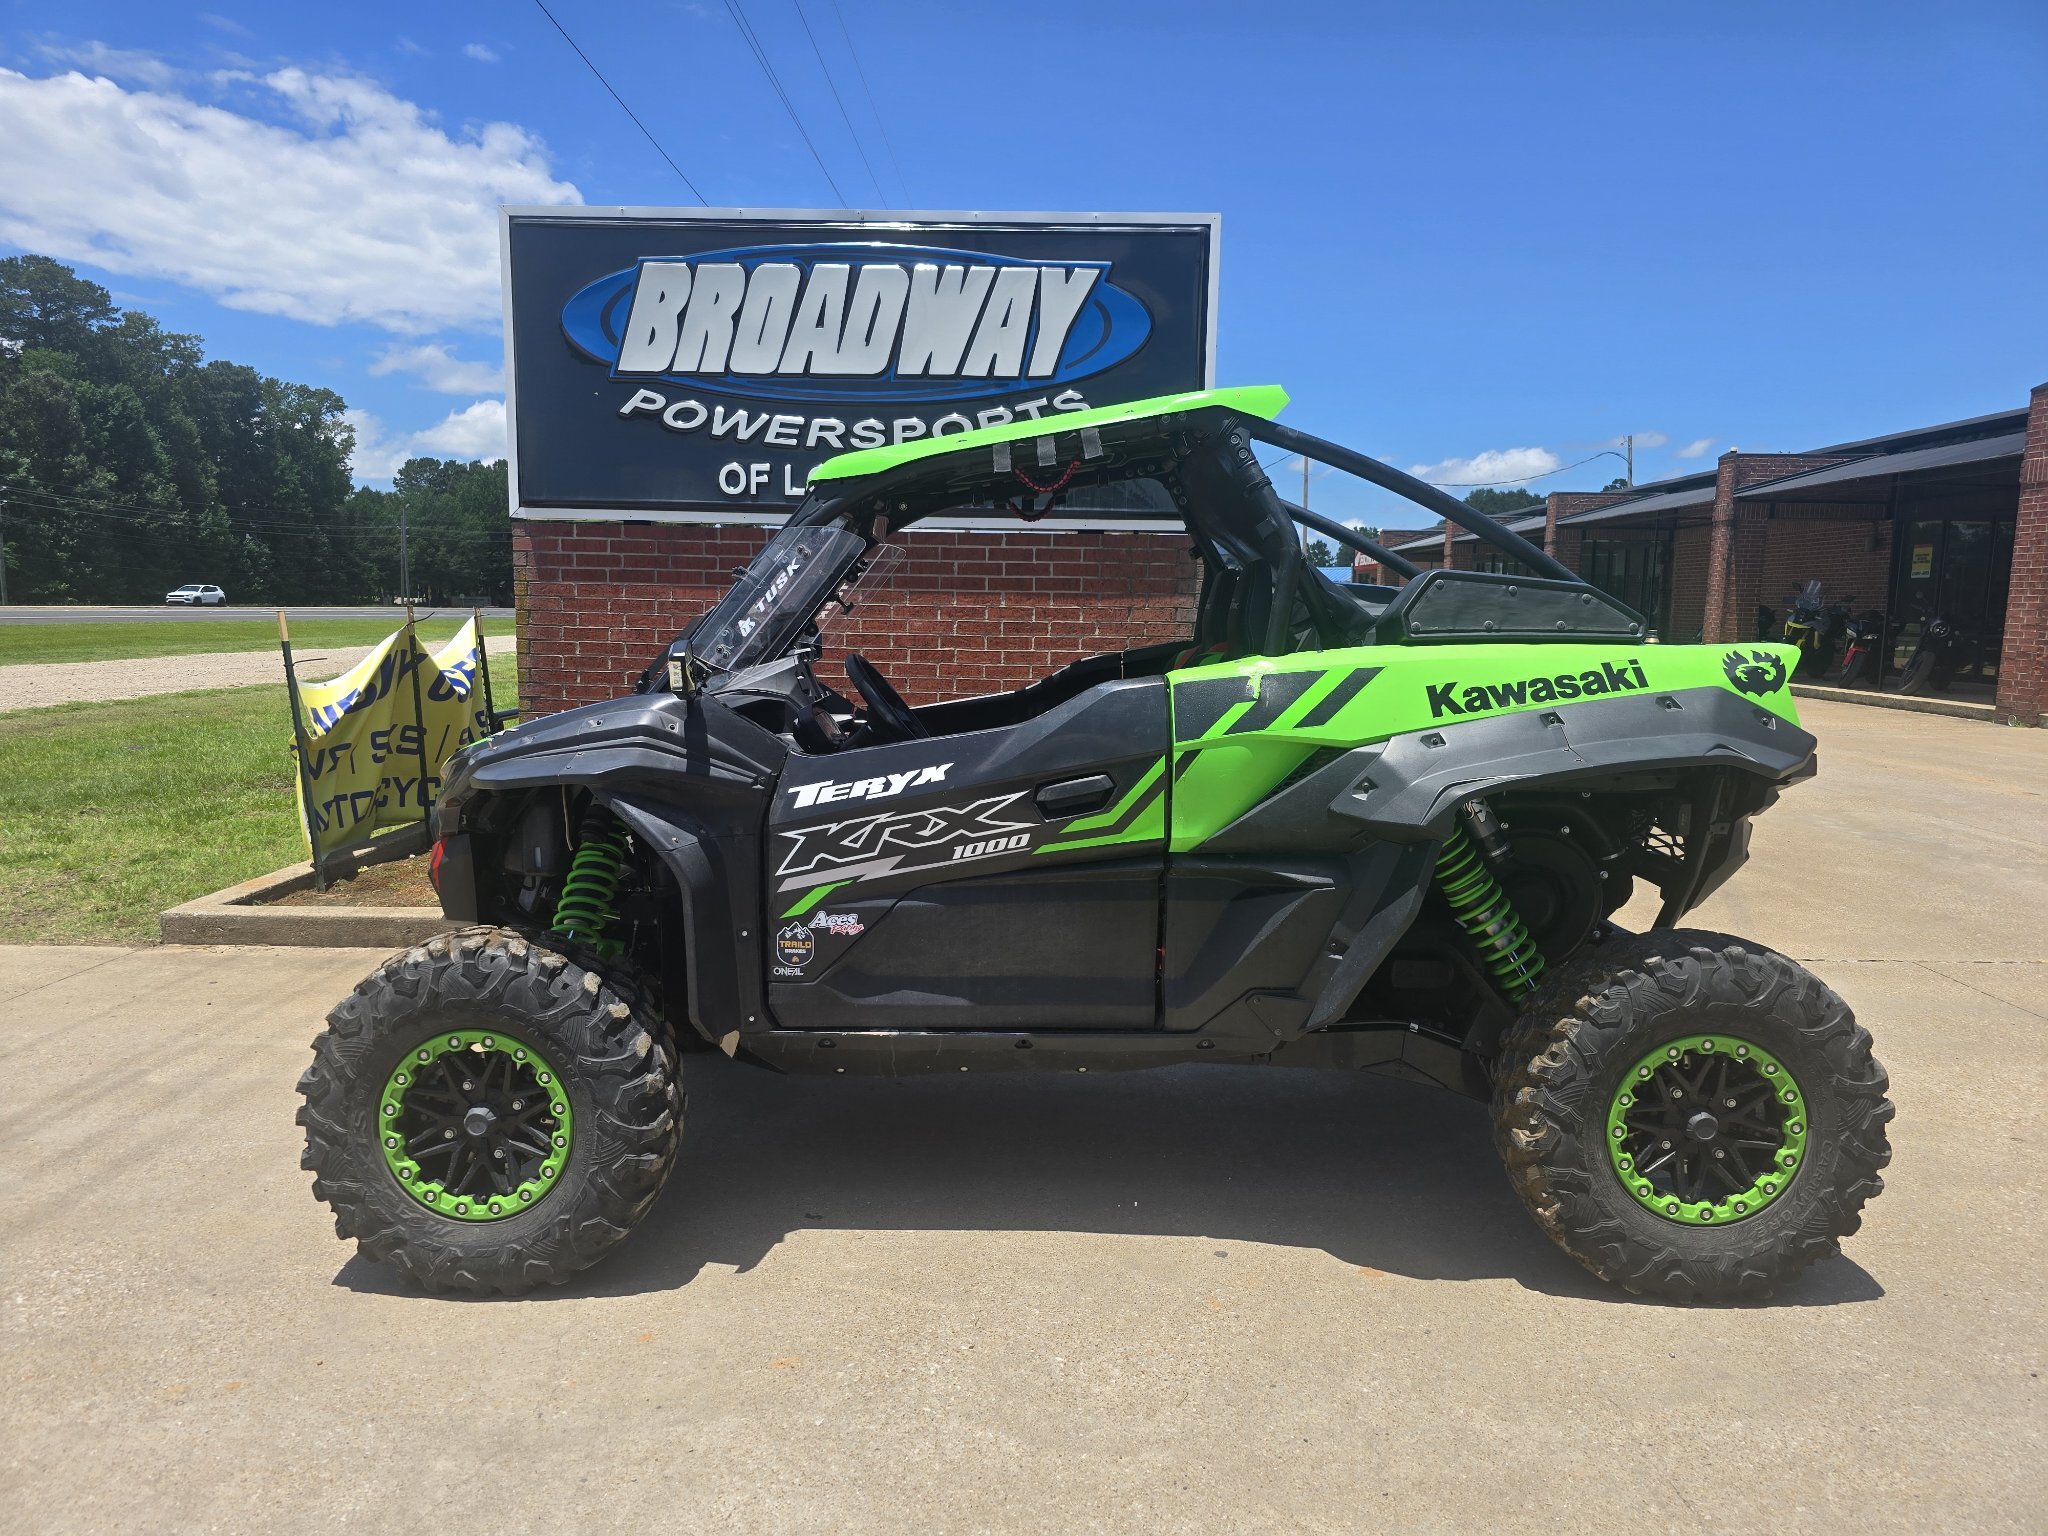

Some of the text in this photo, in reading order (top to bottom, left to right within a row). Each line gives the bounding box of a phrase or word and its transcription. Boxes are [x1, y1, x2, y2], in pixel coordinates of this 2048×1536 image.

[617, 262, 1099, 378] BROADWAY
[718, 462, 771, 495] OF
[755, 556, 801, 613] TUSK
[1425, 659, 1649, 718] Kawasaki
[787, 762, 955, 809] TERYX
[775, 789, 1041, 876] KRX
[952, 833, 1031, 860] 1000
[807, 911, 858, 928] Aces
